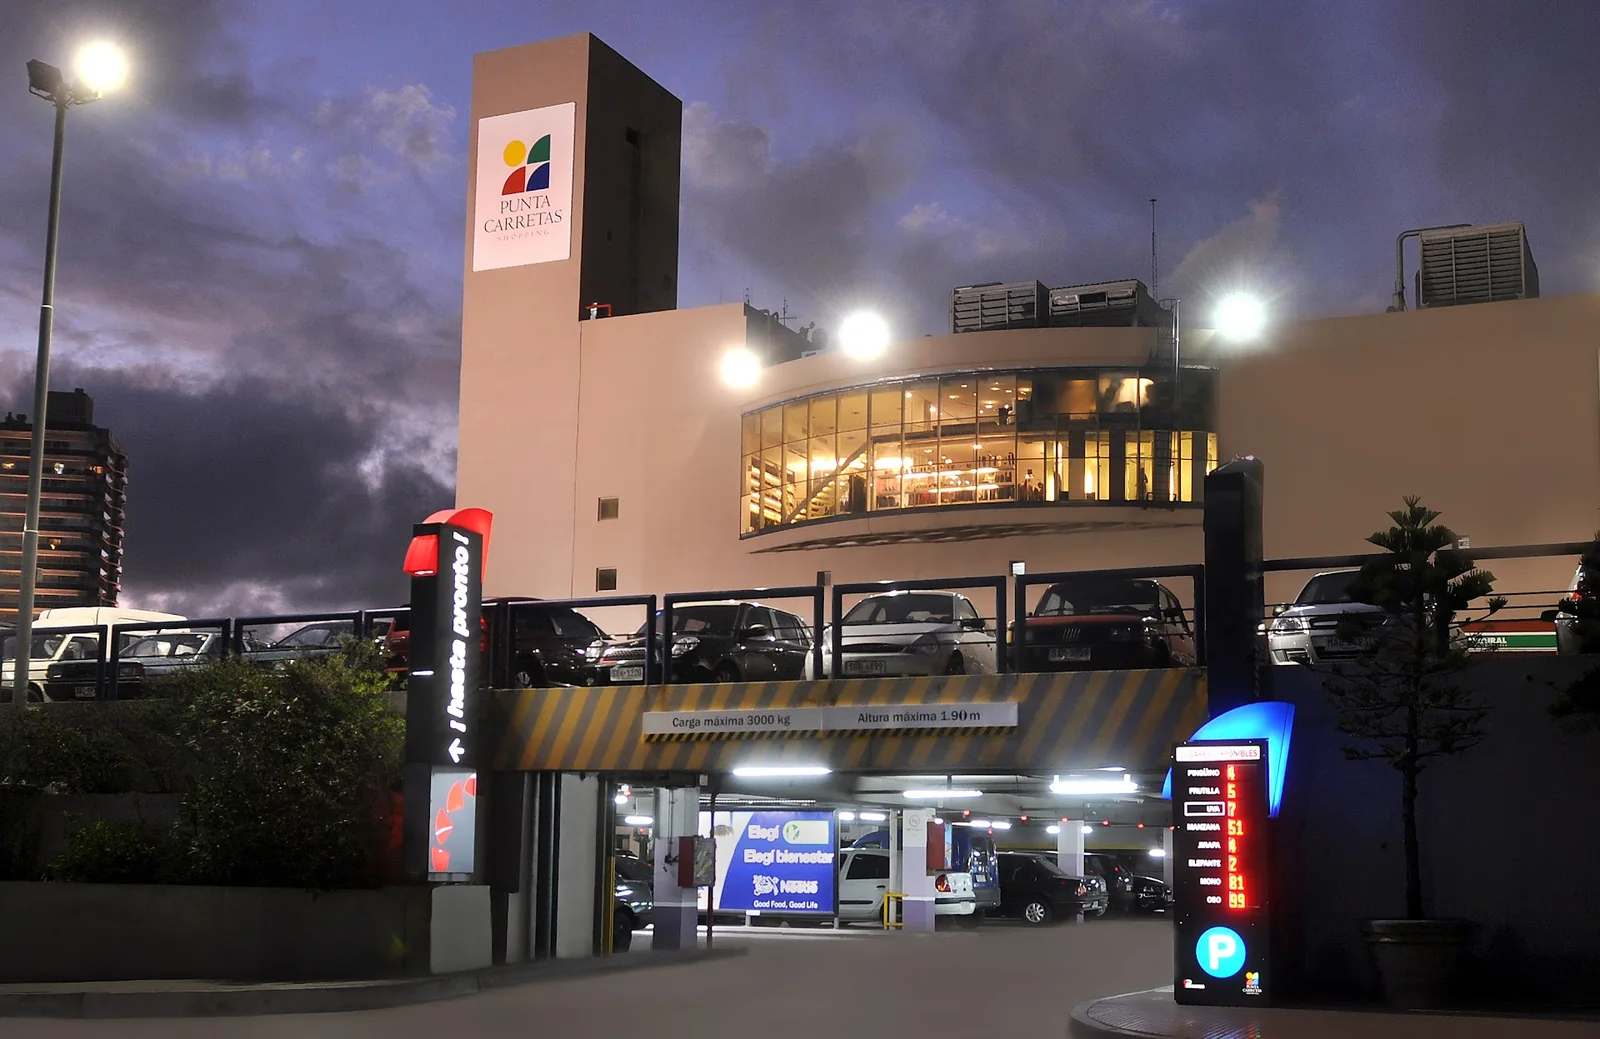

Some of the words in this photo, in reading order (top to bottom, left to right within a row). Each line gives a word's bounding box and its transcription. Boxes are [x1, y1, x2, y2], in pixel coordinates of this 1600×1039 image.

[500, 195, 551, 214] PUNTA
[484, 209, 563, 233] CARRETAS
[497, 229, 549, 241] SHOPPING
[672, 717, 701, 729] Carga
[704, 715, 744, 727] máxima
[747, 714, 775, 725] 3000
[777, 714, 791, 726] kg
[857, 712, 890, 723] Altura
[892, 711, 937, 722] máxima
[940, 710, 967, 721] 1.90
[969, 712, 980, 721] m
[1188, 786, 1220, 795] FRUTILLA
[1228, 782, 1236, 799] 5
[1206, 805, 1220, 813] UVA
[1228, 801, 1236, 817] 7
[1187, 823, 1220, 831] MANZANA
[1228, 819, 1243, 835] 51
[776, 849, 835, 864] bienestar
[1188, 859, 1221, 867] ELEFANTE
[1229, 856, 1237, 872] 2
[1200, 877, 1222, 885] MONO
[1229, 874, 1244, 890] 81
[753, 900, 770, 908] Good
[770, 900, 788, 909] Food,
[789, 900, 806, 909] Good
[806, 900, 818, 909] Life
[1206, 896, 1222, 904] OSO
[1229, 892, 1245, 908] 99
[1208, 934, 1237, 970] P
